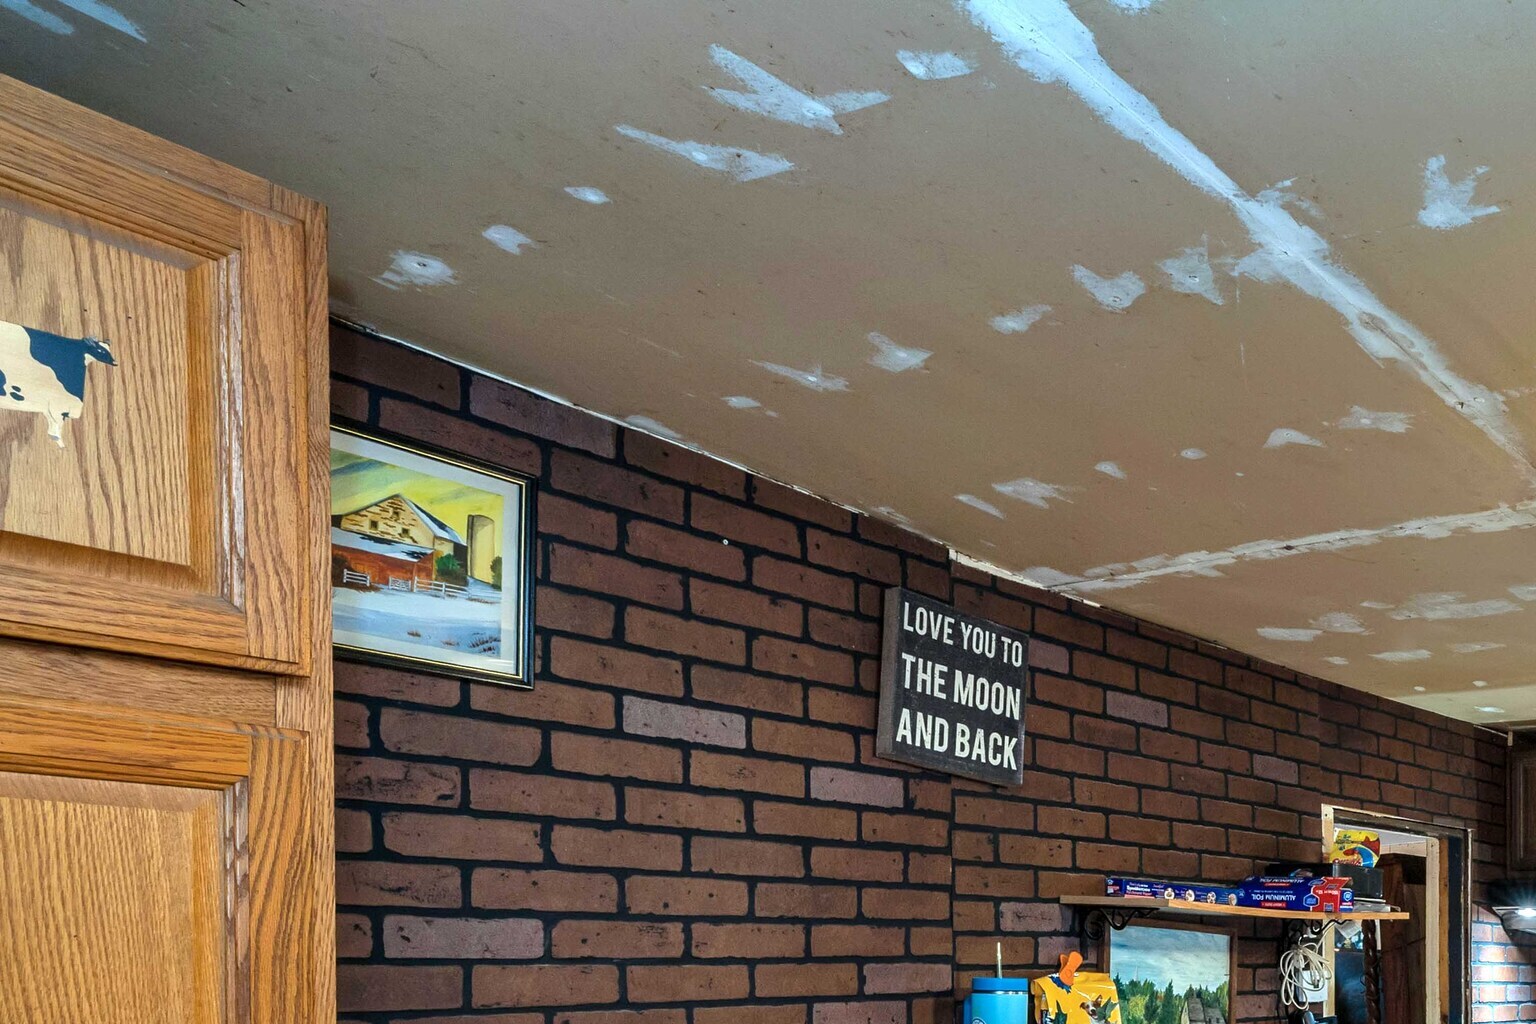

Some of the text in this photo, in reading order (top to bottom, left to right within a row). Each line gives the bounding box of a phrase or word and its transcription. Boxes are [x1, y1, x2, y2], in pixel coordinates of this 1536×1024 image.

[903, 601, 1023, 668] LOVE YOU TO
[901, 652, 1021, 721] THE MOON
[895, 708, 1018, 770] AND BACK
[1265, 893, 1296, 901] ALUMINUM
